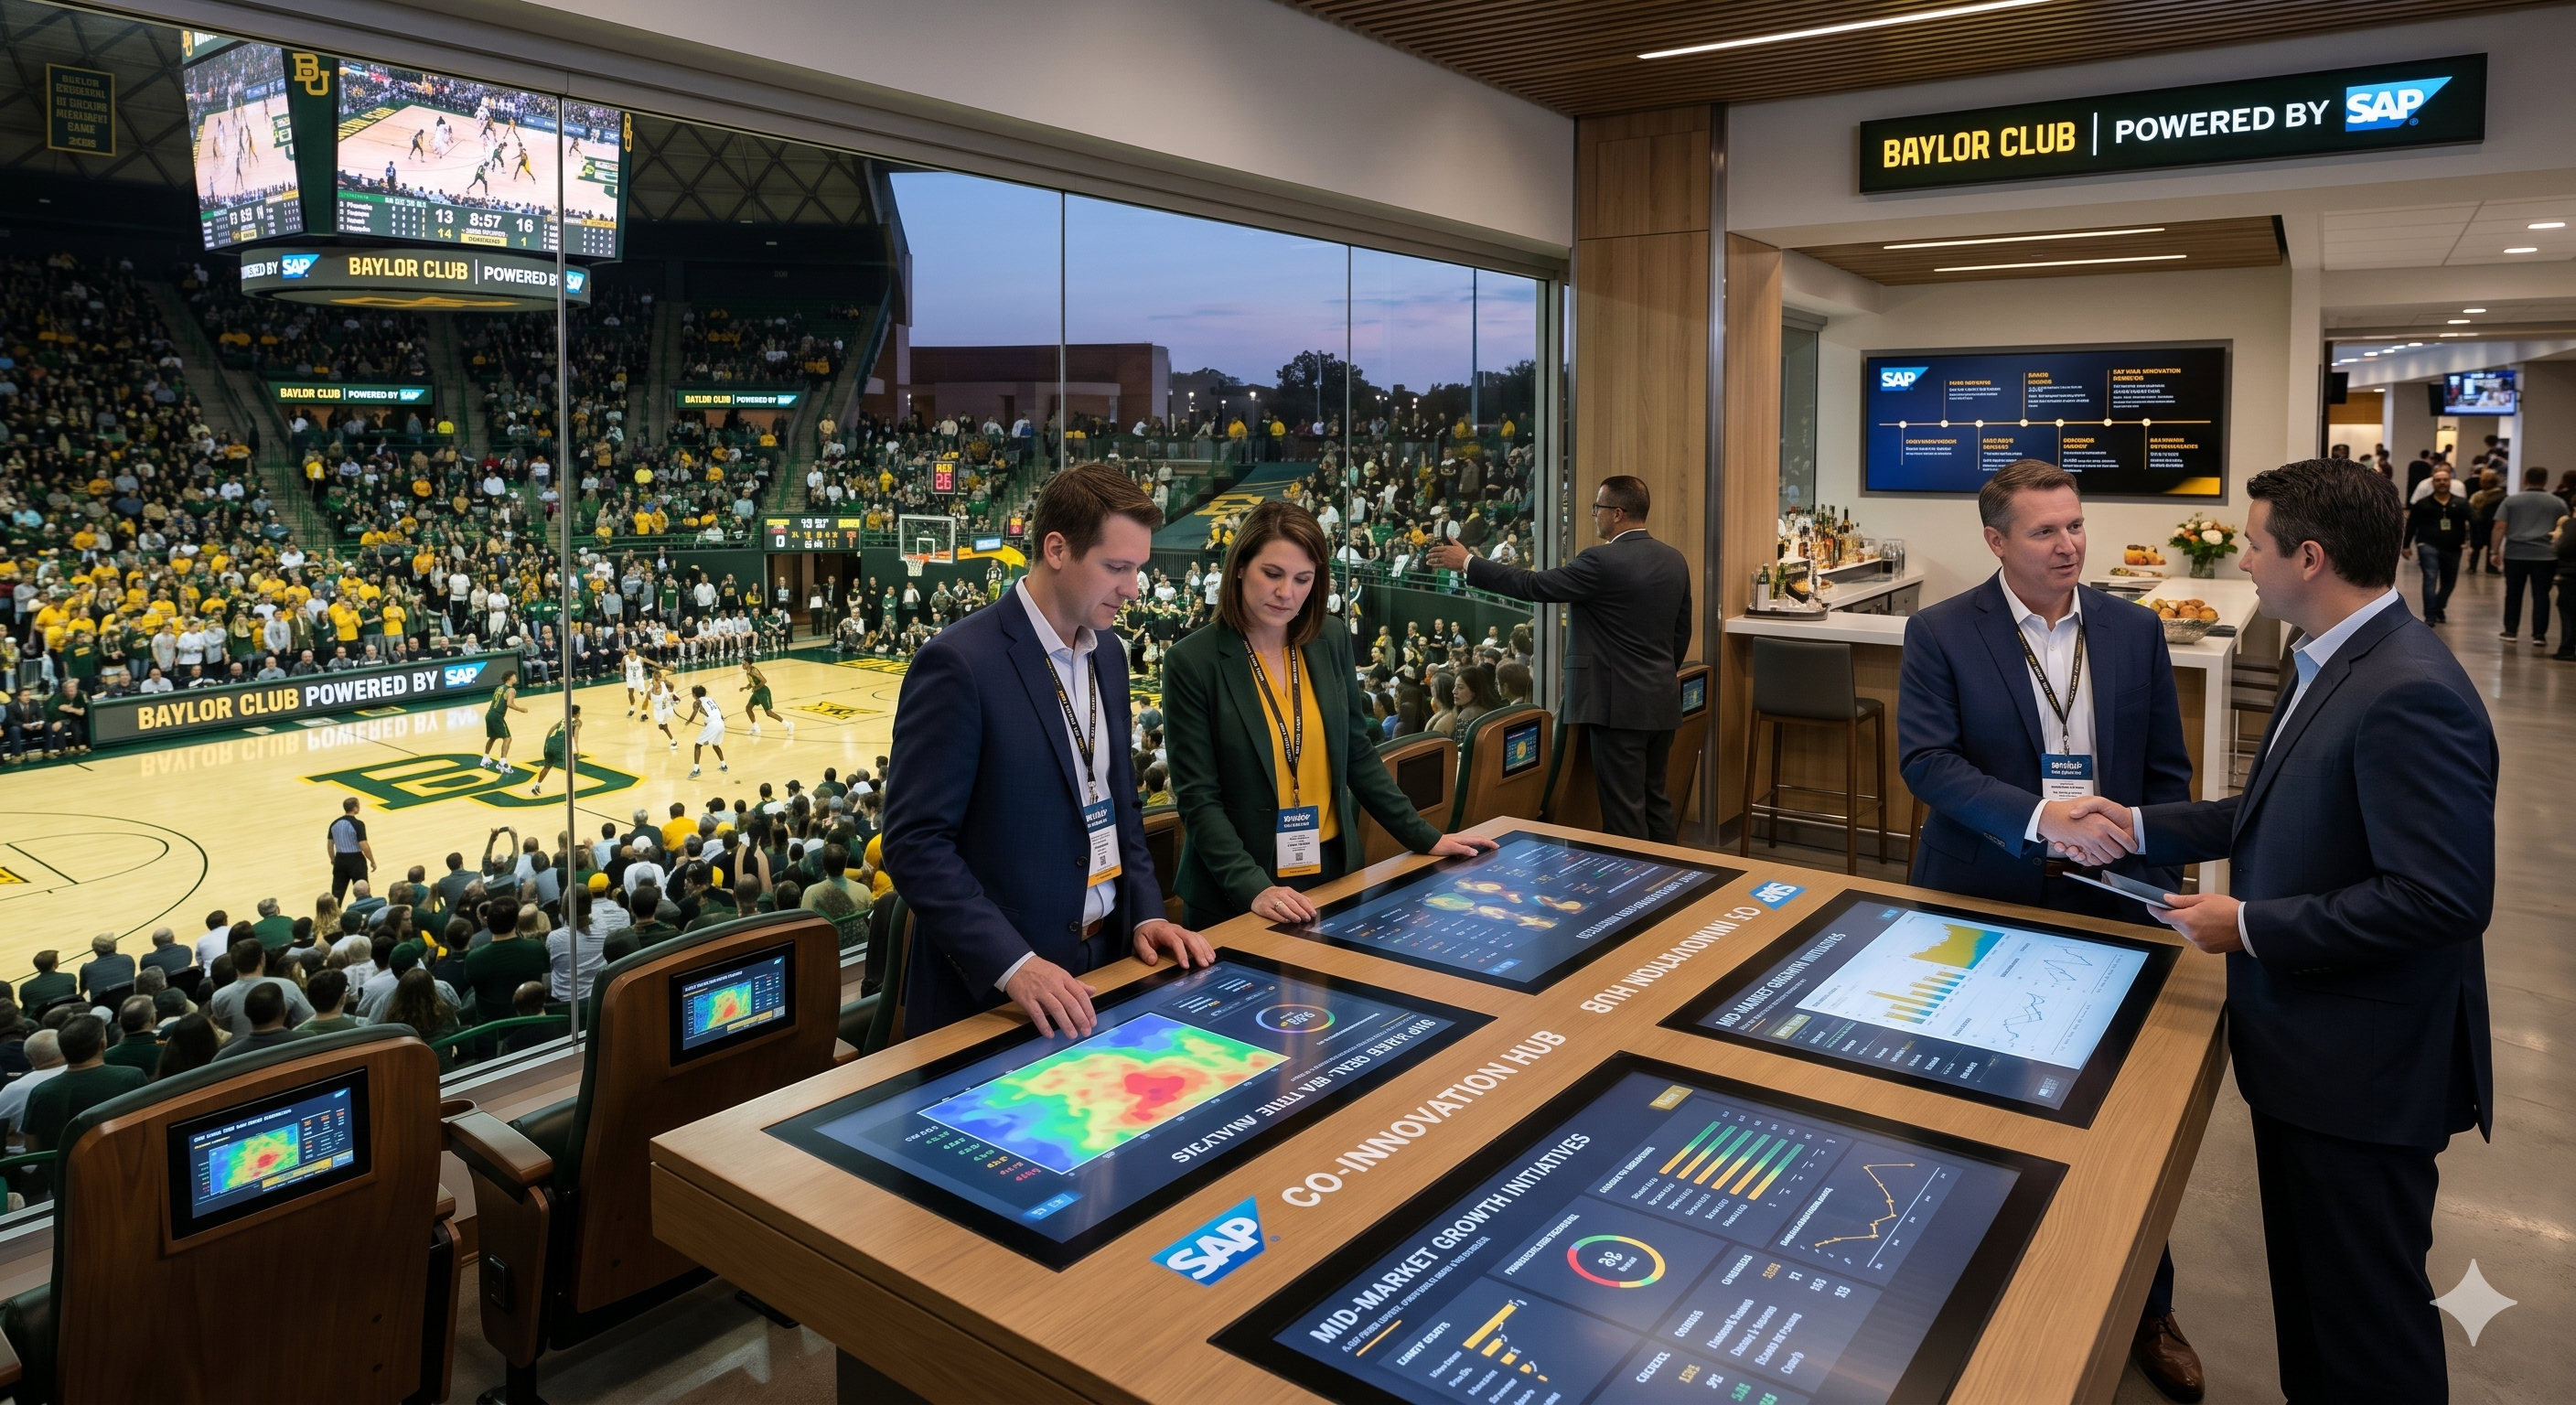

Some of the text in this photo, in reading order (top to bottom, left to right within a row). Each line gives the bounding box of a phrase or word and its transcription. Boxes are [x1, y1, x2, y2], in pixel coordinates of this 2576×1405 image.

[293, 53, 330, 96] BU
[1883, 88, 2425, 168] BAYLOR CLUB POWERED BY SAP
[435, 209, 533, 233] 13 8:57 16
[437, 228, 452, 240] 14
[266, 261, 278, 275] BY
[282, 258, 311, 275] SAP
[349, 256, 419, 277] BAYLOR
[424, 260, 468, 280] CLUB
[484, 265, 548, 285] POWERED
[549, 271, 558, 287] B
[280, 388, 316, 399] BAYLOR
[317, 388, 341, 399] CLUB
[349, 390, 387, 400] POWERED
[388, 391, 398, 400] BY
[1882, 371, 1916, 388] SAP
[137, 666, 478, 731] BAYLOR CLUB POWERED BY SAP
[1580, 983, 1639, 1014] HUB
[1281, 1061, 1519, 1208] CO-INNOVATION
[1499, 1029, 1568, 1067] HUB
[1166, 1217, 1259, 1281] SAP
[1309, 1246, 1439, 1345] MID-MARKET
[1431, 1193, 1513, 1250] GROWTH
[1501, 1132, 1591, 1197] INITIATIVES
